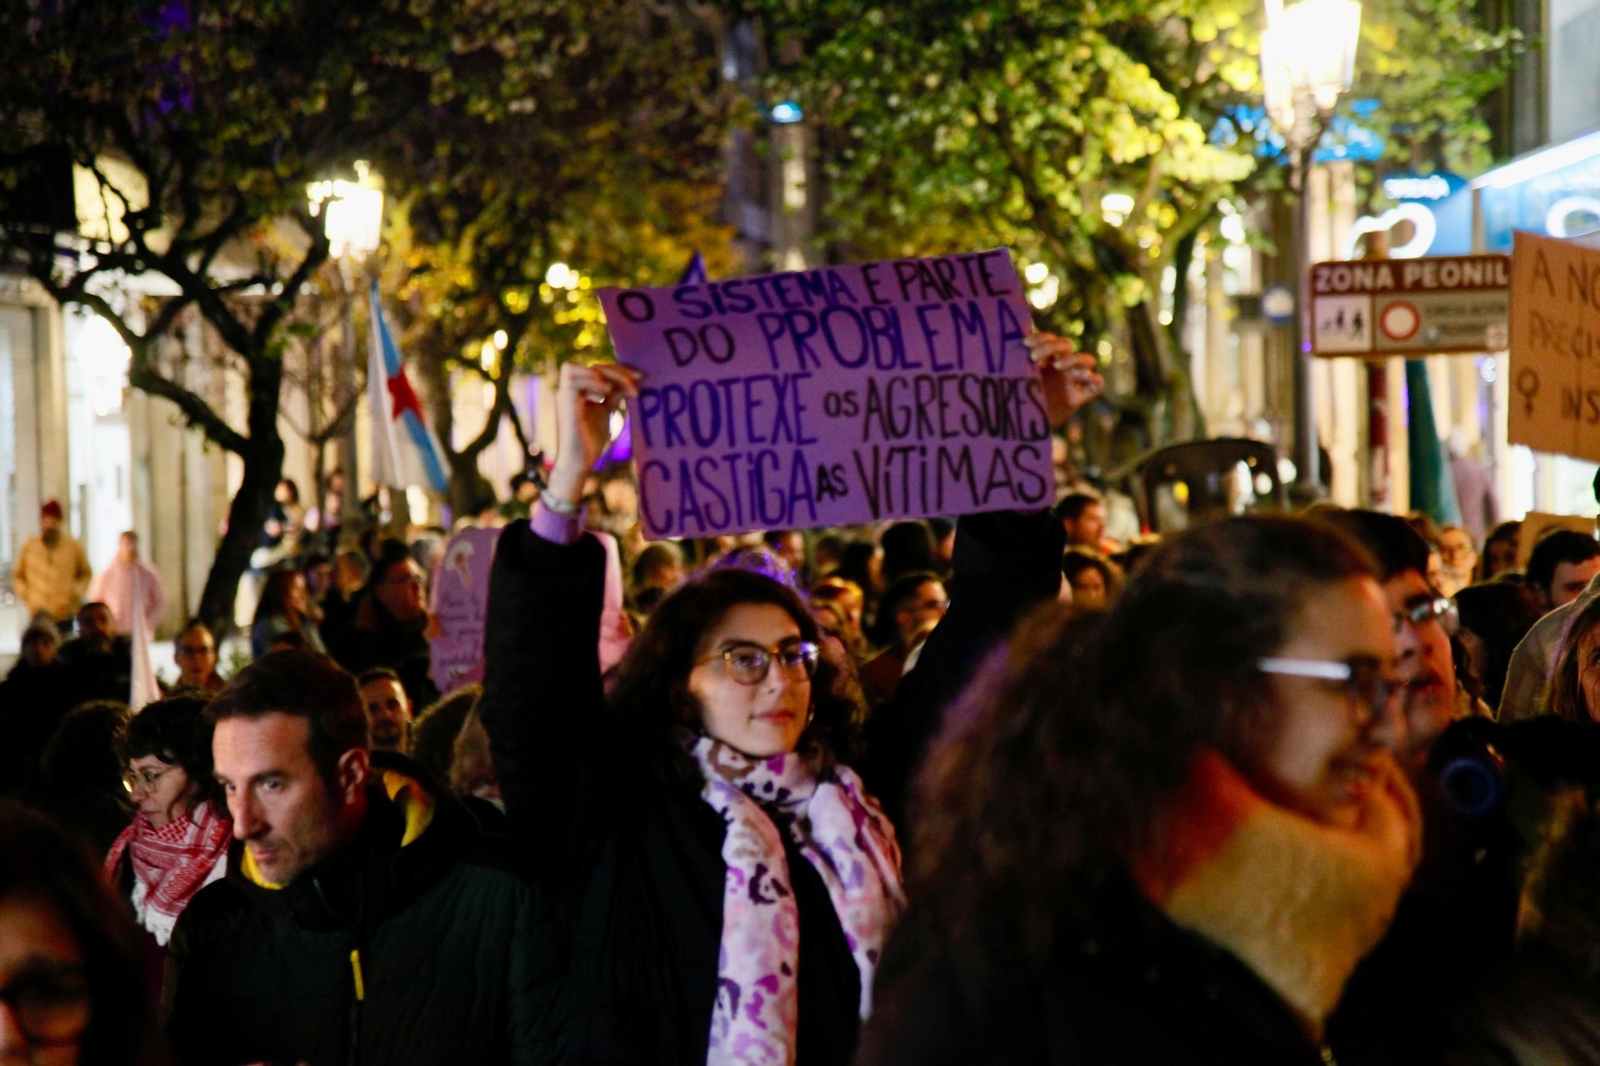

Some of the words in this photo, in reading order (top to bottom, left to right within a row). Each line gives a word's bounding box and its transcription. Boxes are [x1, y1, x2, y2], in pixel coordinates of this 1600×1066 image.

[616, 290, 655, 324] O
[893, 251, 1011, 302] PARTE
[1314, 264, 1395, 293] ZONA
[1402, 259, 1509, 289] PEONIL
[662, 323, 736, 368] DO
[756, 298, 1025, 374] PROBLEMA
[637, 371, 818, 449] PROTEXE
[862, 373, 1050, 442] AGRESORES
[815, 462, 849, 503] AS
